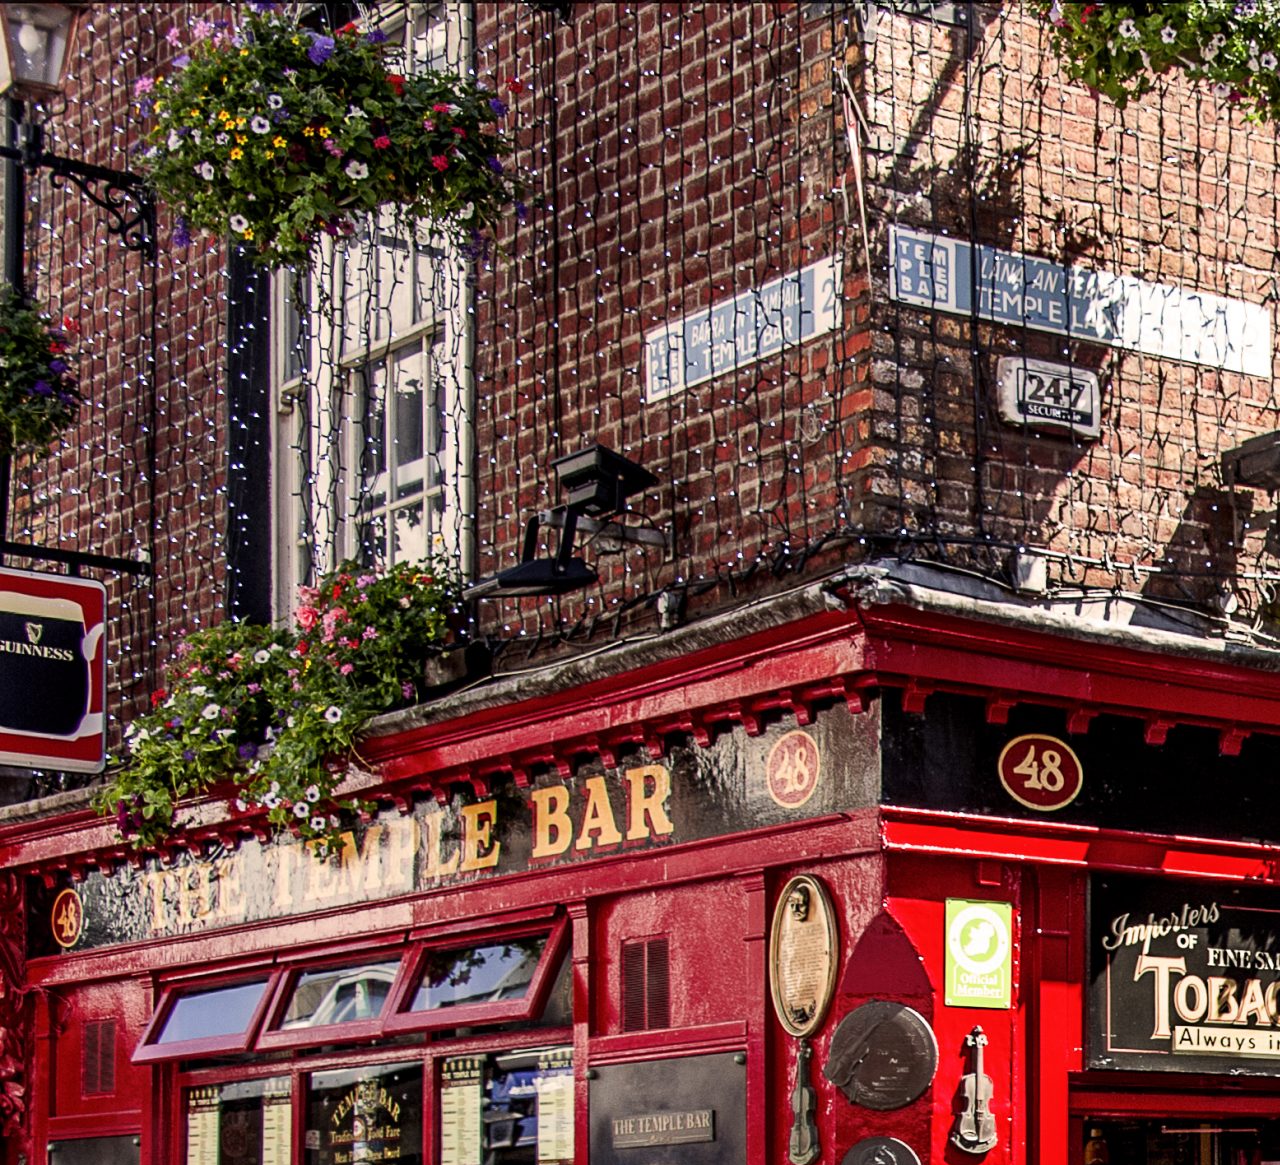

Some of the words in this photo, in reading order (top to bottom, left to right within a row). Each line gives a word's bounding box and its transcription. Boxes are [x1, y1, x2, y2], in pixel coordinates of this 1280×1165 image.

[901, 275, 948, 301] BAR
[1032, 268, 1058, 293] AN
[691, 312, 725, 347] BARRA
[731, 305, 746, 331] AN
[702, 331, 756, 370] TEMPLE
[763, 316, 793, 347] BAR
[774, 747, 810, 795] 48
[1013, 744, 1065, 793] 48
[141, 856, 247, 930] THE
[264, 800, 501, 906] TEMPLE
[530, 763, 675, 859] BAR
[57, 897, 78, 938] 48
[1102, 901, 1220, 954] Importers
[1176, 933, 1199, 949] OF
[1206, 947, 1251, 969] FINE
[1178, 1026, 1256, 1051] Always
[379, 1088, 401, 1122] BAR
[613, 1119, 636, 1136] THE
[638, 1114, 684, 1133] TEMPLE
[686, 1111, 711, 1129] BAR
